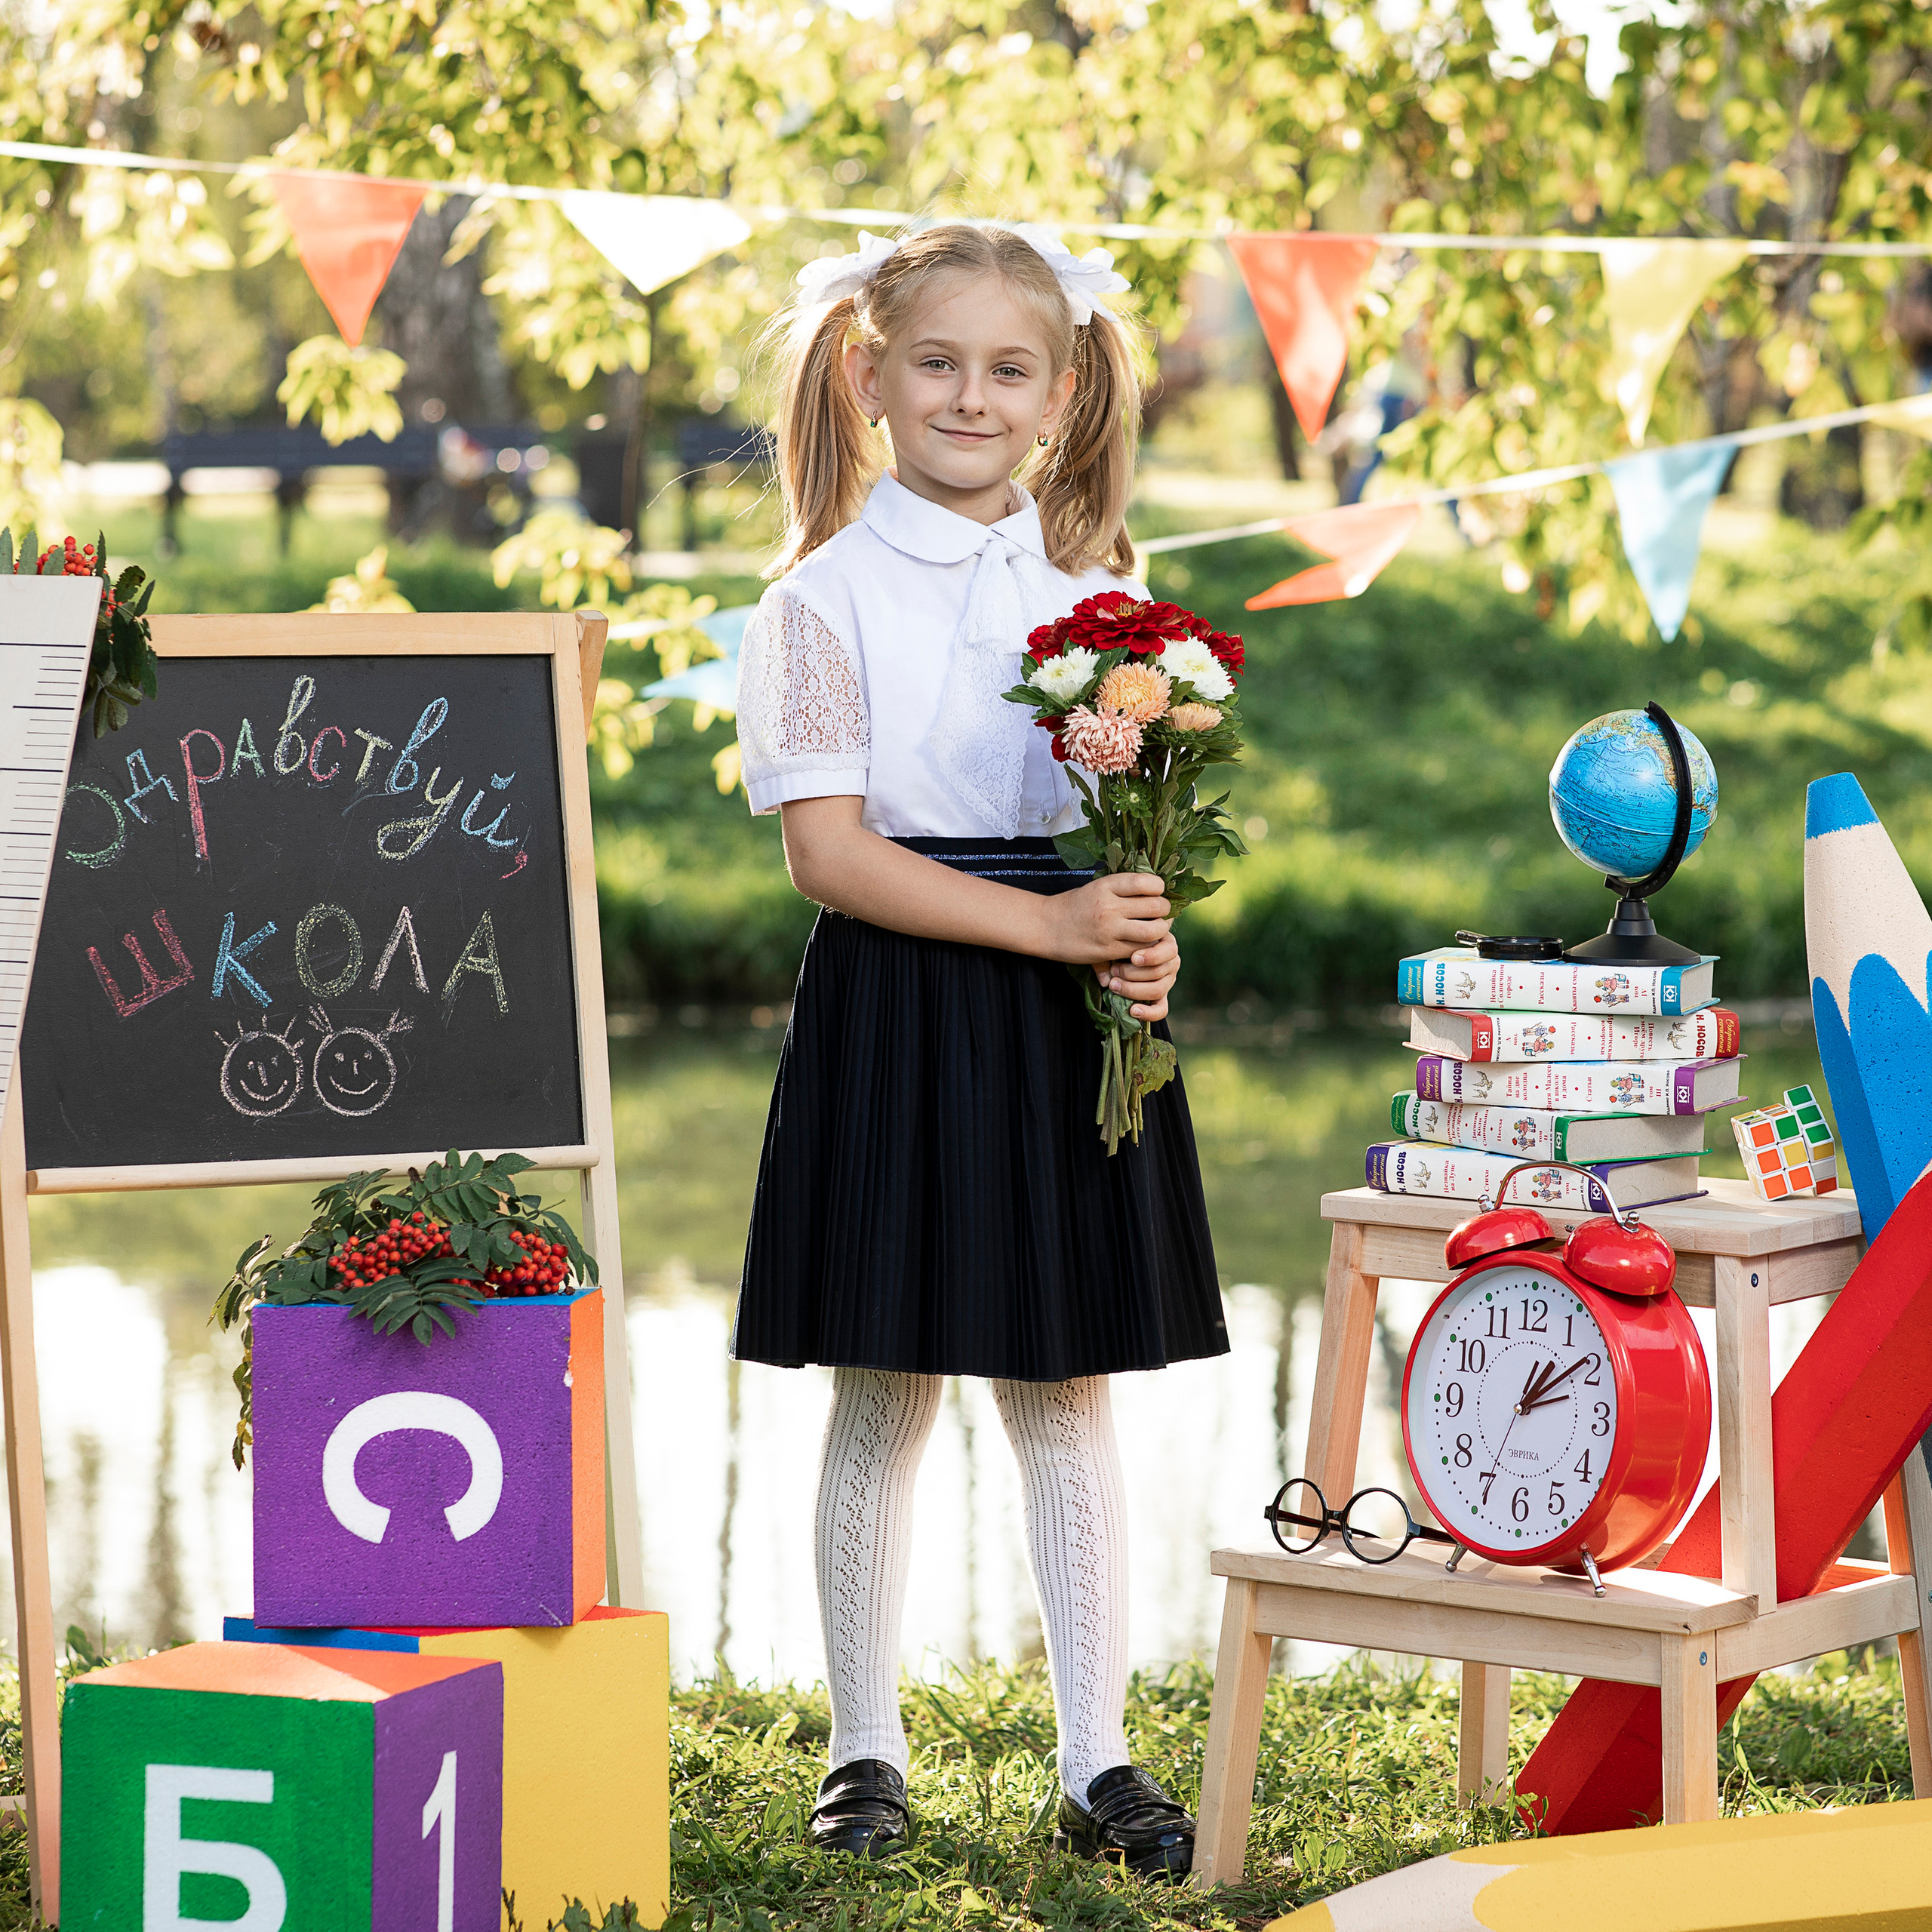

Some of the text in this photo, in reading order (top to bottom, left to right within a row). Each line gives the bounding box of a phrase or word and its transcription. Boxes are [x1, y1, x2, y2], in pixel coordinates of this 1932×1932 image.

[85, 903, 510, 1019] ШКОЛА
[1404, 966, 1414, 1000] Собрание
[1435, 962, 1446, 1005] Н. НОСОВ
[1641, 988, 1647, 997] IV
[1696, 1014, 1706, 1057] Н. НОСОВ
[1726, 1019, 1736, 1052] Собрание
[1423, 1065, 1432, 1099] Собрание
[1453, 1062, 1463, 1094] НОСОВ
[1515, 1090, 1520, 1098] на
[1446, 1103, 1454, 1144] Приключени
[1370, 1154, 1378, 1186] Собрание
[1396, 1152, 1407, 1184] НОСОВ
[1451, 1183, 1455, 1191] на
[1484, 1306, 1511, 1340] 11
[1518, 1298, 1549, 1333] 12
[1561, 1314, 1576, 1348] 1
[1457, 1338, 1486, 1374] 10
[1584, 1352, 1601, 1386] 2
[1445, 1382, 1464, 1418] 9
[1591, 1401, 1611, 1436] 3
[322, 1390, 503, 1545] С
[1454, 1433, 1472, 1468] 8
[1508, 1448, 1540, 1461] ЭВРИКА
[1574, 1448, 1593, 1484] 4
[1478, 1472, 1497, 1506] 7
[1512, 1487, 1530, 1522] 6
[1548, 1481, 1565, 1515] 5
[143, 1763, 288, 1932] Б
[422, 1750, 457, 1932] 1
